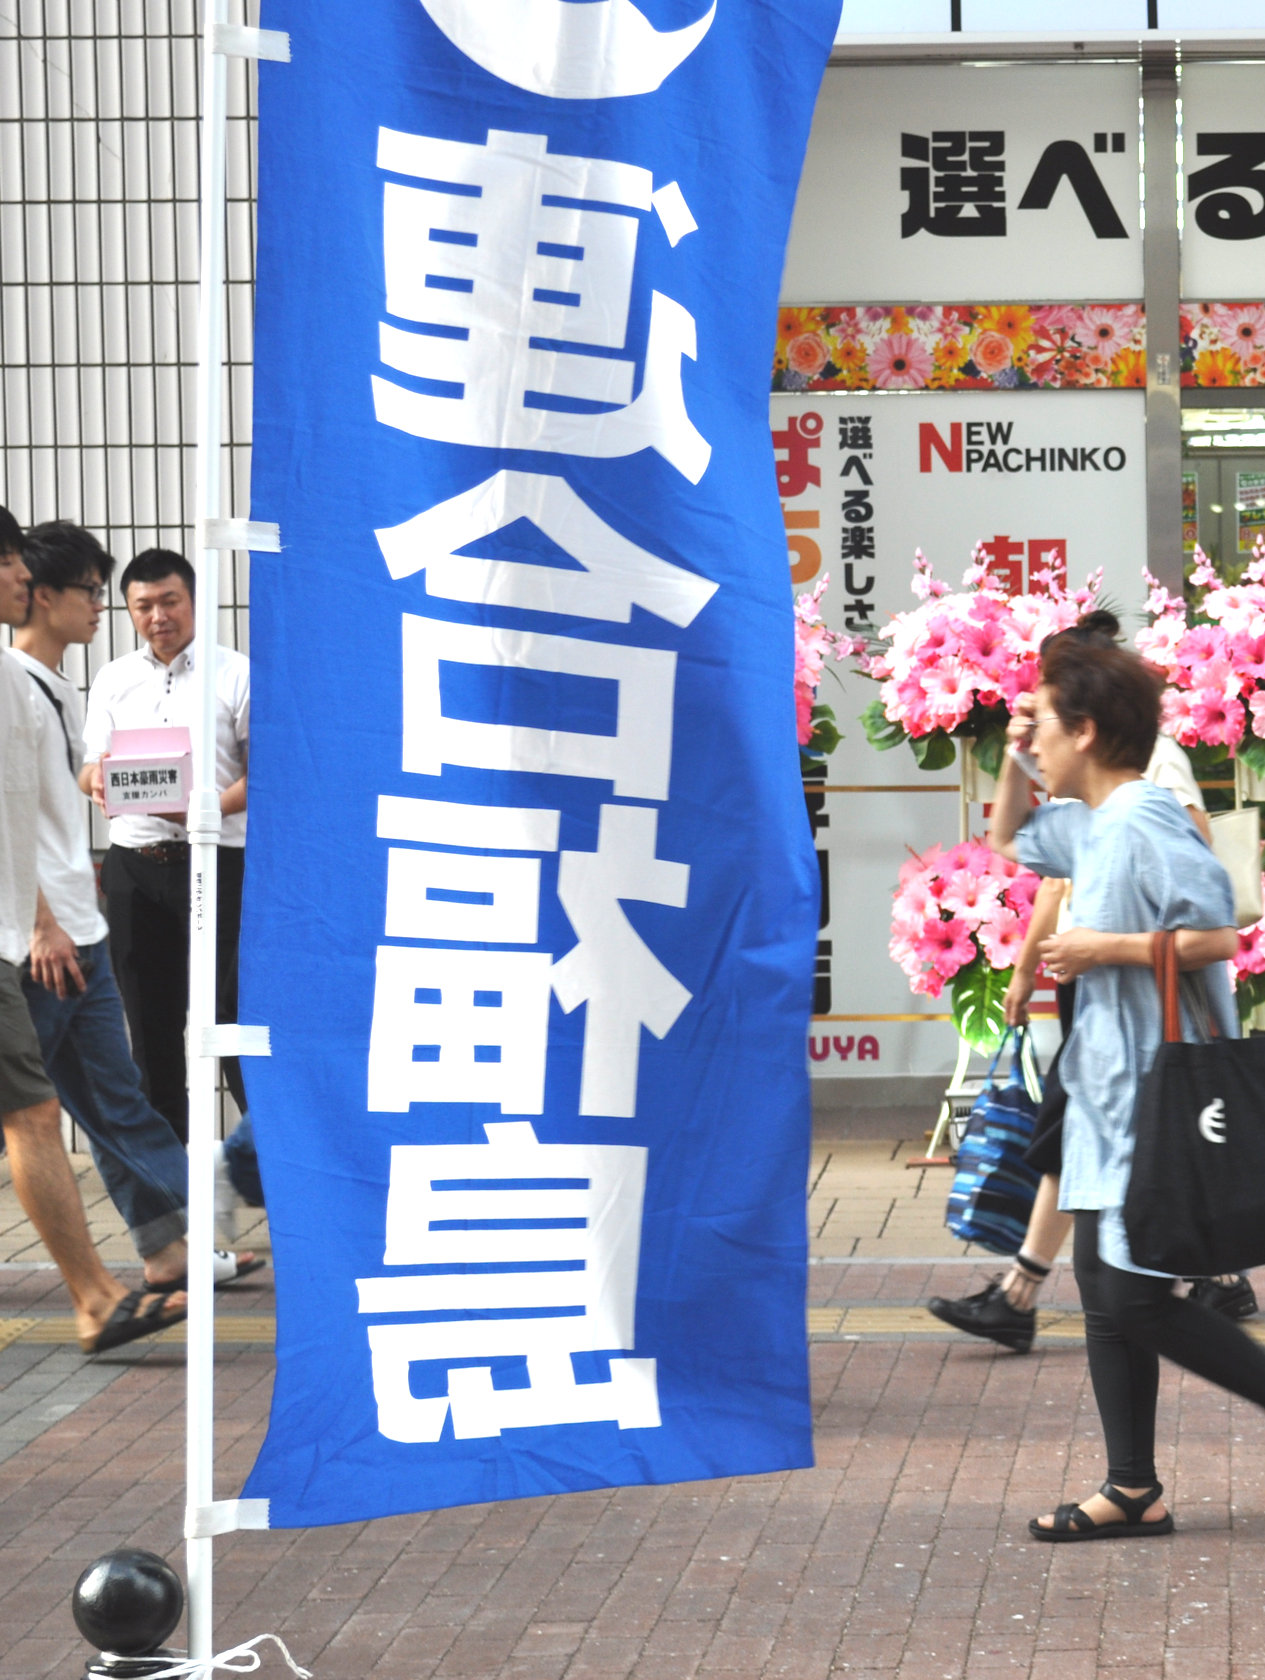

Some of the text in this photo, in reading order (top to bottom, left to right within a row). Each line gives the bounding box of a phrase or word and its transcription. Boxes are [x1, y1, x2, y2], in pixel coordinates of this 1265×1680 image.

[918, 421, 1013, 473] NEW
[965, 446, 1127, 473] PACHINKO
[838, 415, 876, 632] 選べる楽しさ
[110, 768, 178, 788] 西日本豪雨災害
